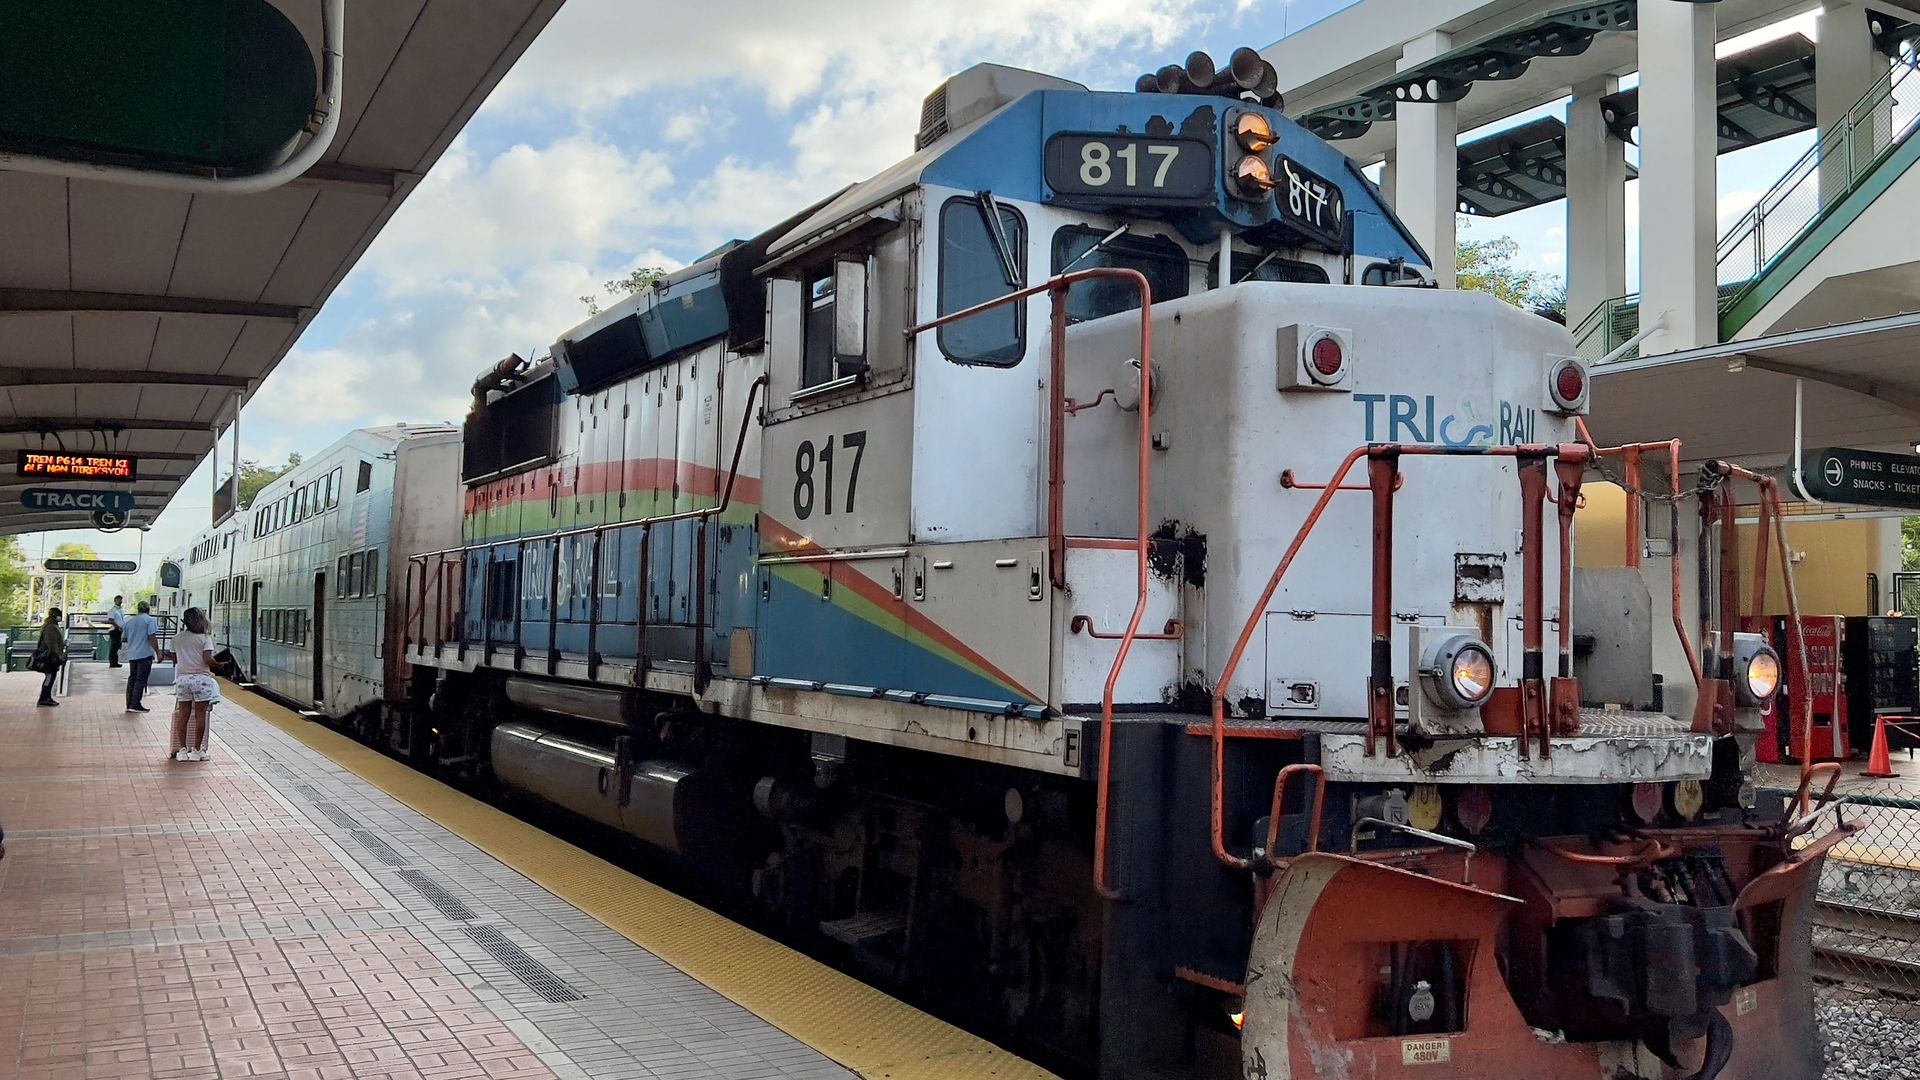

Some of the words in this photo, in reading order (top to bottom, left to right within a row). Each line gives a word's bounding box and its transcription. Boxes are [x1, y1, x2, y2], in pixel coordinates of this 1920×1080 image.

[1079, 141, 1180, 187] 817
[1288, 172, 1327, 227] 817
[1353, 393, 1435, 443] TRI
[26, 454, 54, 464] TREN
[56, 456, 83, 466] P614
[87, 457, 112, 467] TREN
[115, 459, 128, 468] KI
[46, 464, 69, 473] NAN
[1850, 459, 1883, 472] PHONES
[792, 430, 867, 521] 817
[1852, 478, 1885, 491] SNACKS
[31, 492, 106, 508] TRACK
[1066, 733, 1078, 762] F
[1406, 1041, 1446, 1051] DANGER!
[1413, 1051, 1439, 1062] 480V
